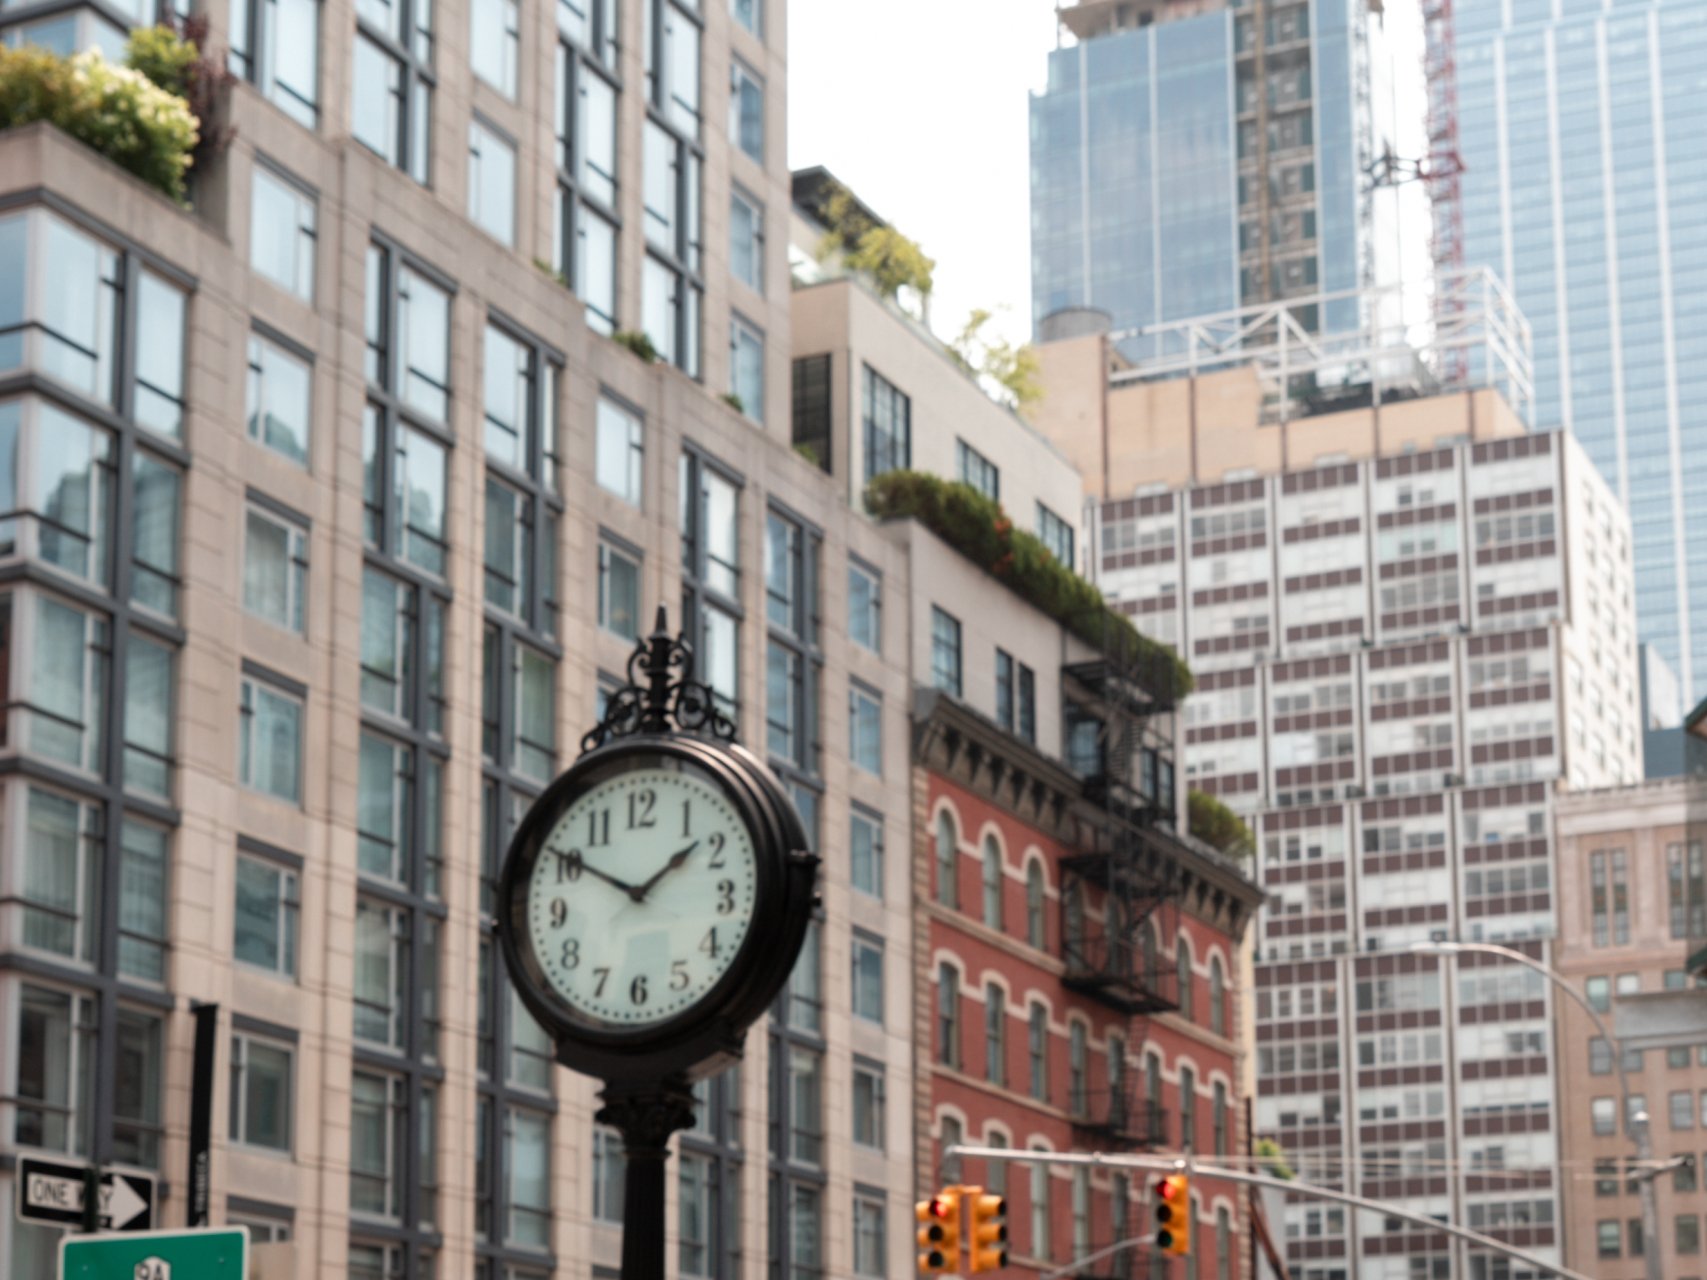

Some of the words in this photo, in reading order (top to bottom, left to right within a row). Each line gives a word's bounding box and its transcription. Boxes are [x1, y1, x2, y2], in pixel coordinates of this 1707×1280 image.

[627, 788, 656, 831] 12
[681, 799, 691, 838] 1
[588, 808, 610, 847] 11
[556, 847, 582, 885] 10
[708, 832, 726, 869] 2
[549, 897, 567, 929] 9
[717, 879, 735, 915] 3
[561, 938, 579, 970] 8
[699, 926, 721, 959] 4
[592, 967, 611, 998] 7
[630, 975, 647, 1006] 6
[669, 960, 690, 991] 5
[32, 1178, 70, 1207] ONE
